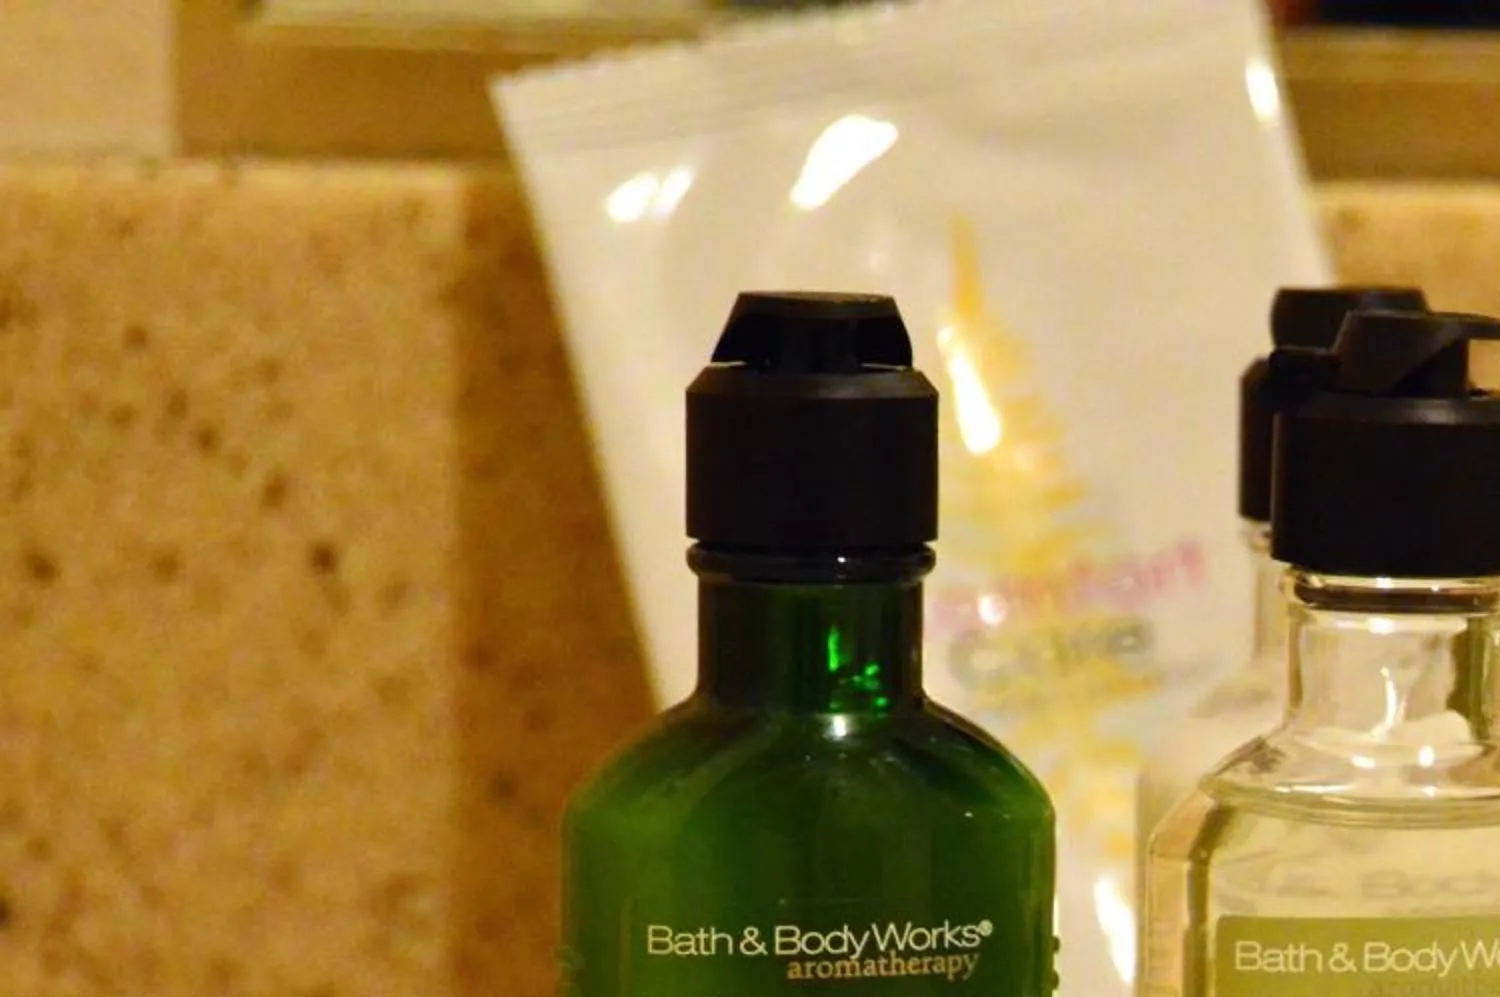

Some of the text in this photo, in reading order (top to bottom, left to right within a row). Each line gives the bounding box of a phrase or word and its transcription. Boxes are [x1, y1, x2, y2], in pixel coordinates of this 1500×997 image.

[647, 924, 734, 956] Bath
[739, 925, 768, 956] &
[774, 923, 869, 959] Body
[1235, 940, 1323, 973] Bath
[1328, 942, 1357, 973] &
[1363, 941, 1457, 977] Body
[787, 951, 980, 982] aromatherapy
